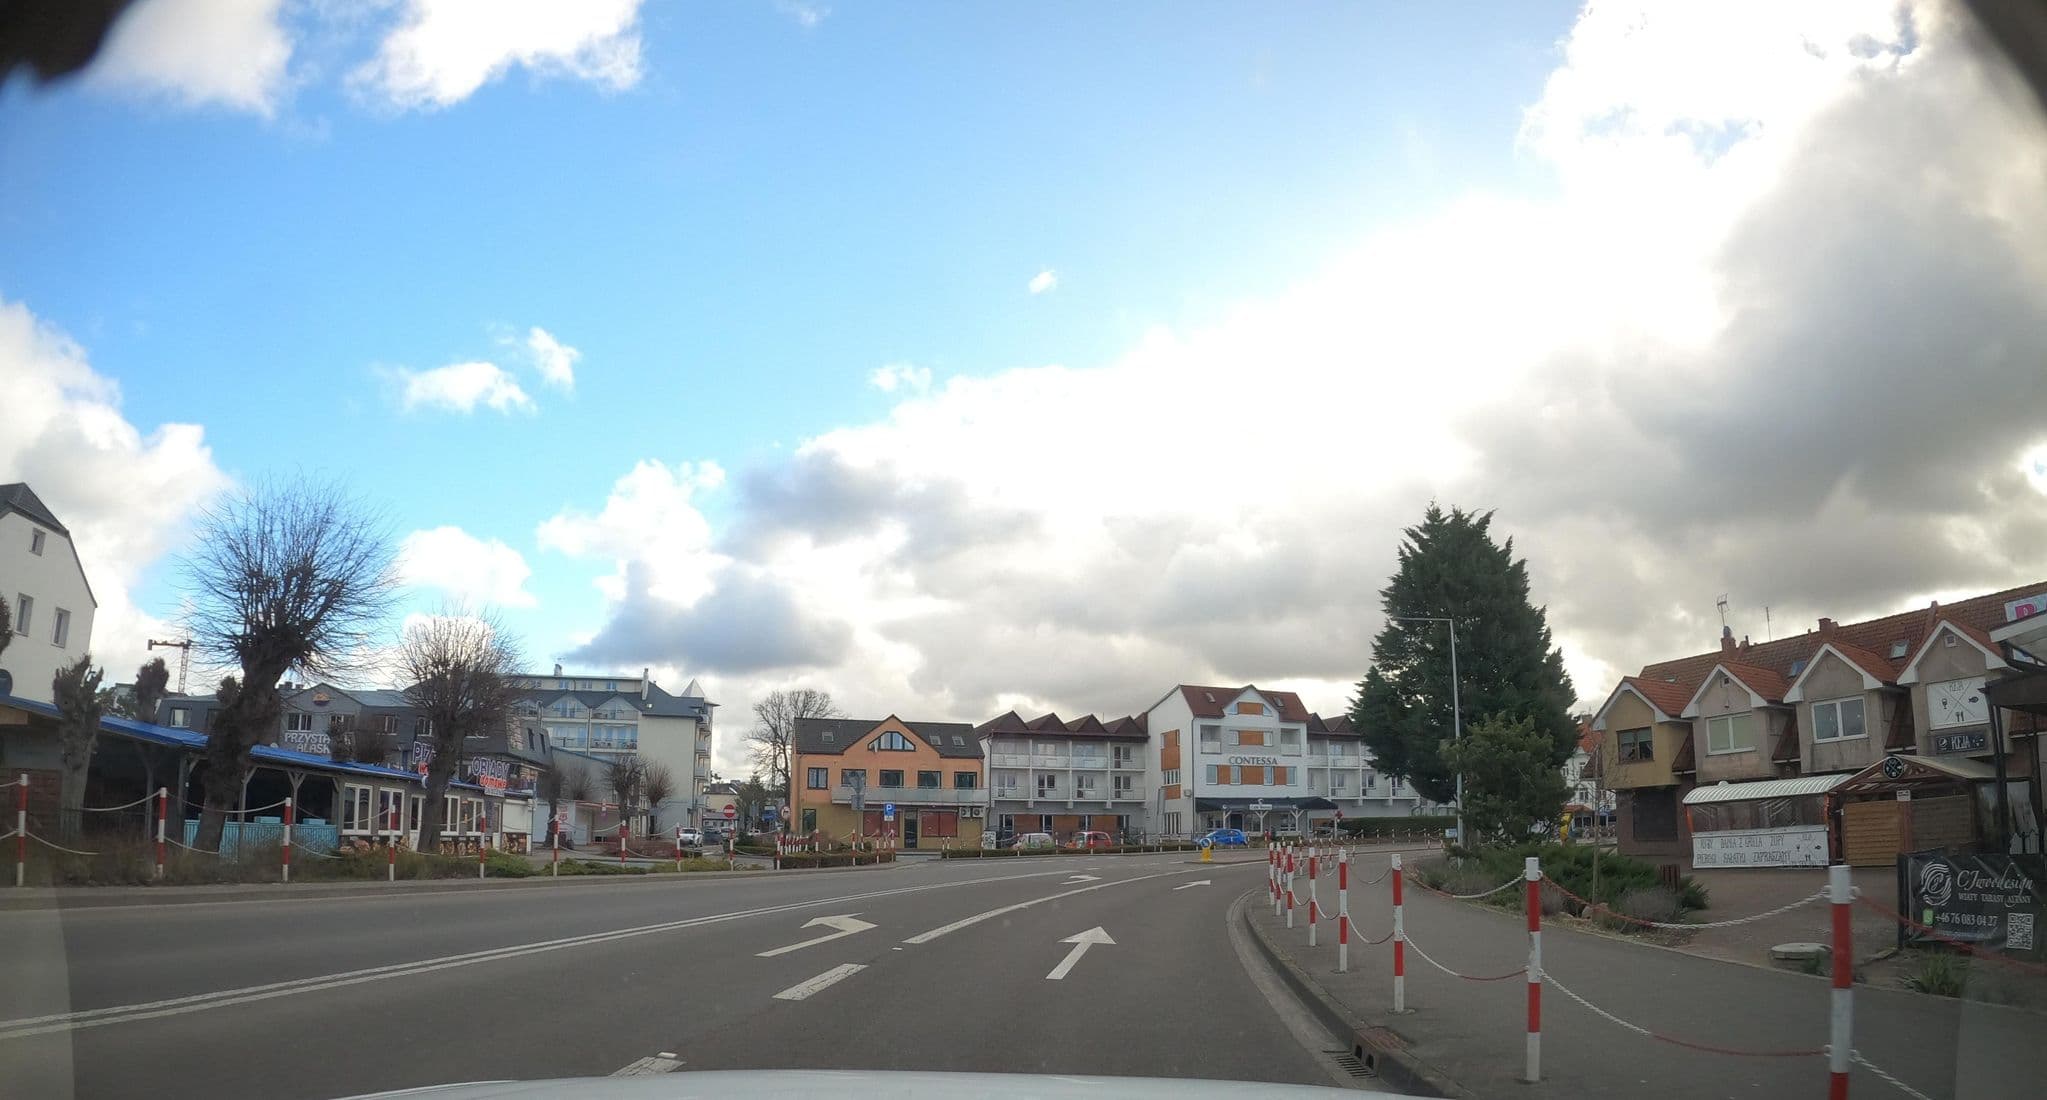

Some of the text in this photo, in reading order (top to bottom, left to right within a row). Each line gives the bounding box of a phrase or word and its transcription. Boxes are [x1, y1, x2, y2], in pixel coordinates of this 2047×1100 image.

[285, 732, 331, 743] PRZYSTA
[1951, 735, 1970, 750] KEJA
[296, 743, 331, 754] ALASK
[1229, 755, 1278, 765] CONTESSA
[472, 756, 510, 778] OBIADY
[1950, 912, 1960, 924] 76
[1961, 913, 1976, 925] 083
[1986, 915, 1998, 927] 27
